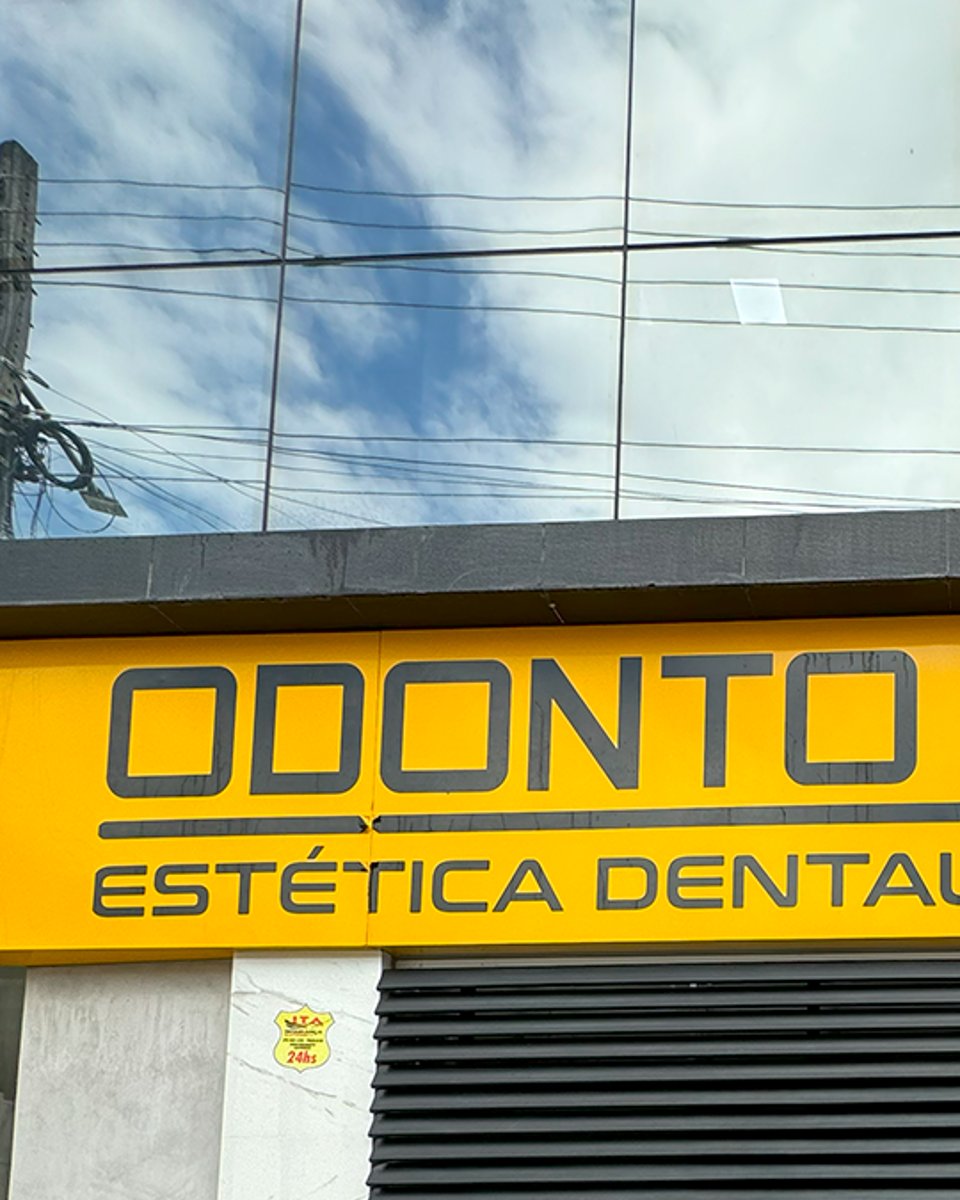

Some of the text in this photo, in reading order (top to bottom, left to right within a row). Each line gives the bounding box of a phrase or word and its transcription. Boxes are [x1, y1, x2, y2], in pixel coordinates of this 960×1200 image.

[107, 650, 917, 798] ODONTO
[93, 845, 563, 917] ESTÉTICA
[287, 1050, 318, 1064] 24hs
